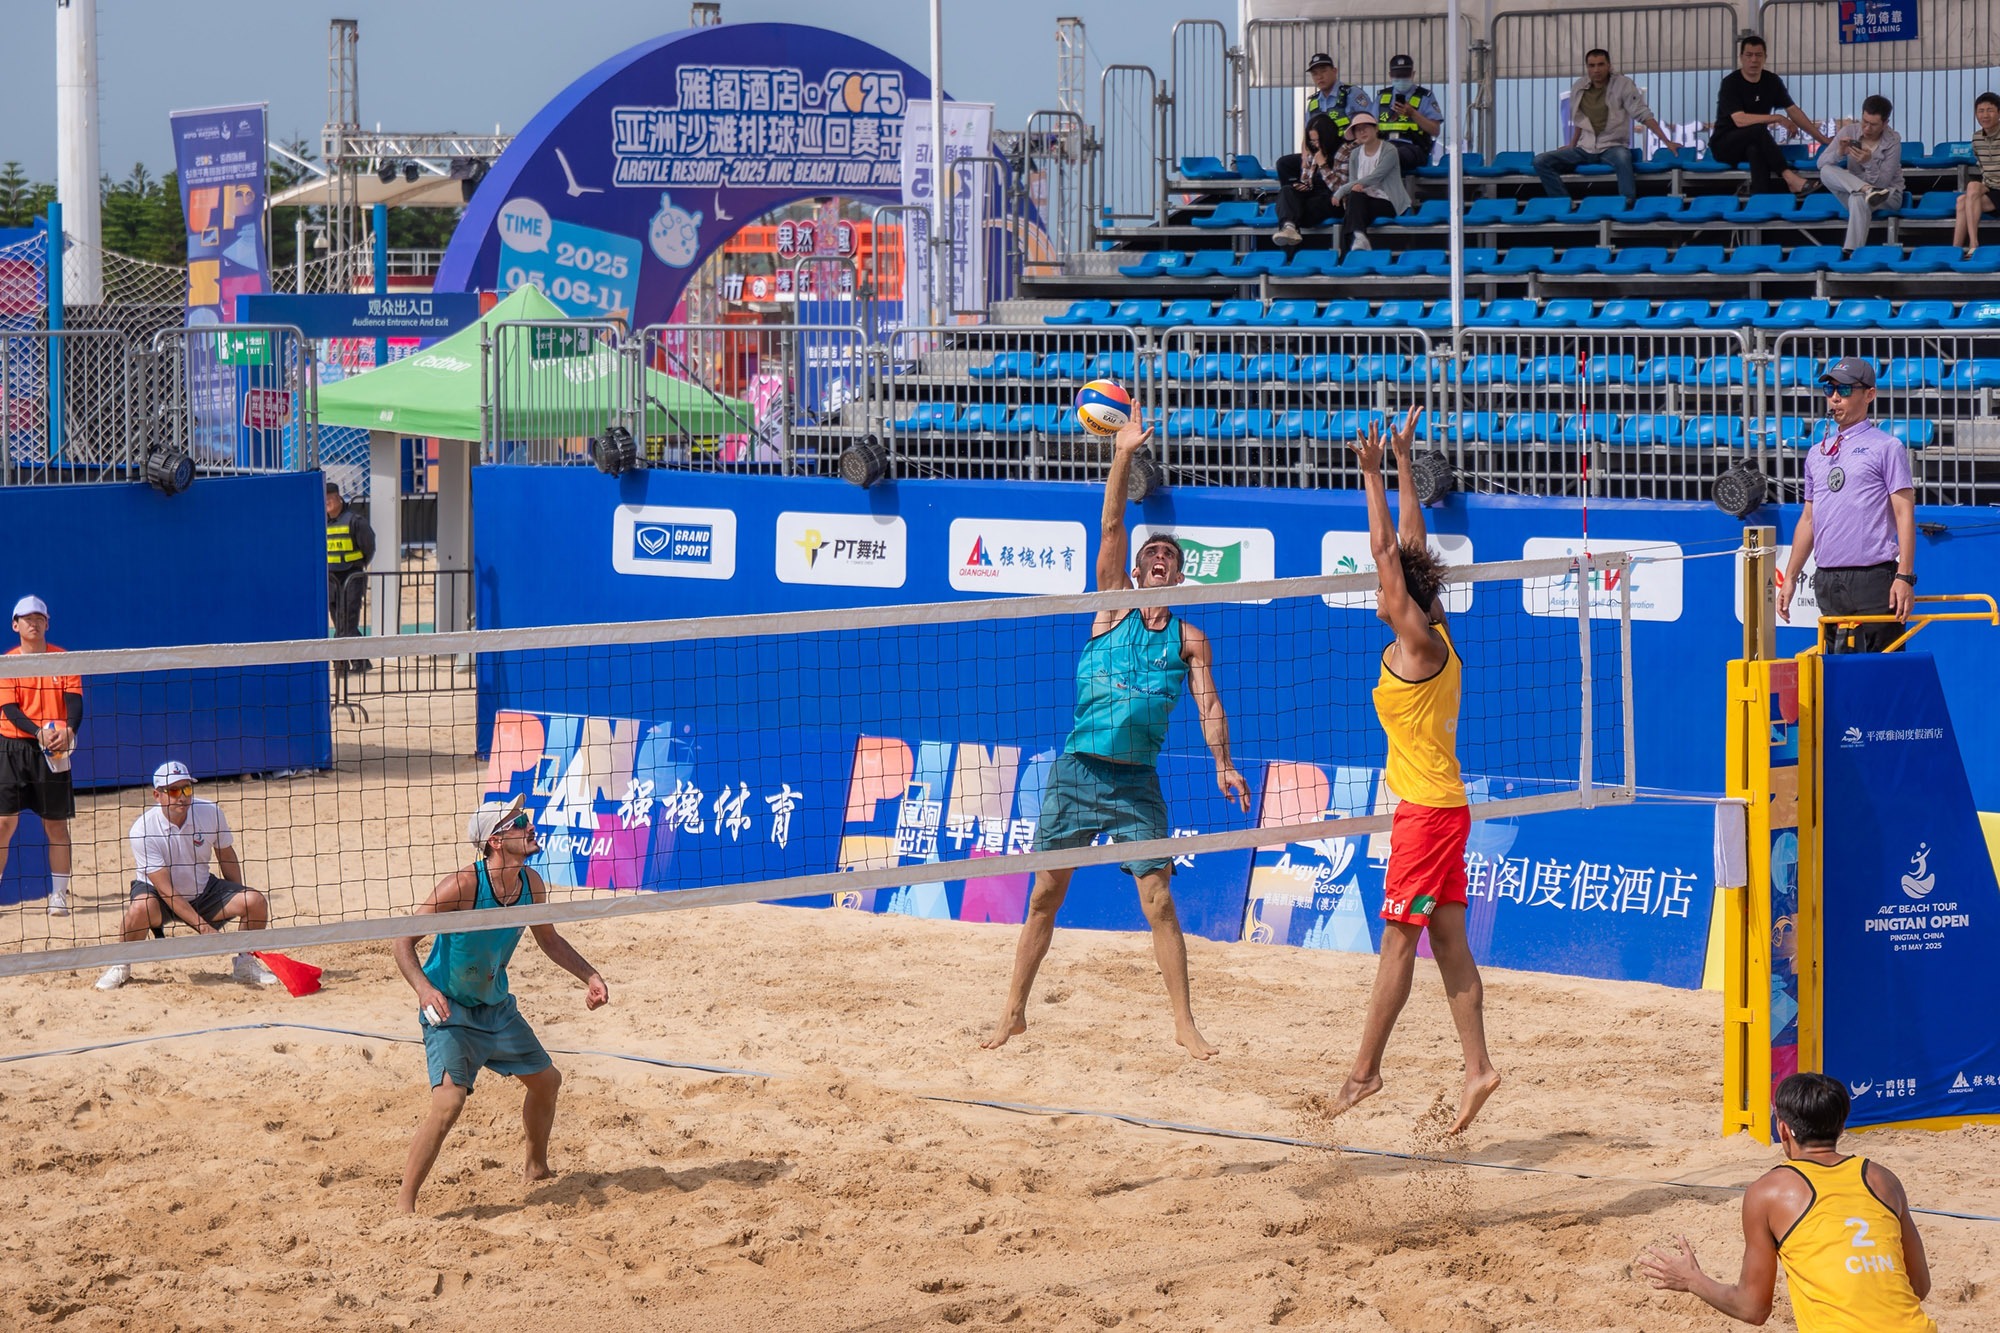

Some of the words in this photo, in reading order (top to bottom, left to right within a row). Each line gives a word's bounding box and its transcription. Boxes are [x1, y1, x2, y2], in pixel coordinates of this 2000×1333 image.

[1854, 10, 1903, 26] 请勿倚靠
[1868, 24, 1901, 34] LEANING
[681, 71, 798, 112] 雅阁酒店
[618, 160, 668, 182] ARGYLE
[671, 160, 721, 182] RESORT
[731, 161, 767, 183] 2025
[767, 162, 794, 183] AVC
[794, 162, 835, 184] BEACH
[836, 163, 870, 184] TOUR
[504, 213, 543, 237] TIME
[555, 242, 629, 280] 2025
[368, 299, 433, 316] 观众出入口
[352, 317, 385, 327] Audience
[386, 317, 418, 327] Entrance
[419, 317, 433, 327] And
[434, 317, 448, 327] Exit
[674, 530, 710, 543] GRAND
[674, 544, 709, 557] SPORT
[833, 539, 887, 561] PT舞社
[999, 545, 1076, 572] 强槐体育
[958, 568, 1000, 578] QIANGHUAI
[617, 777, 803, 850] 强槐体育
[1271, 852, 1331, 882] Argyle
[1309, 881, 1356, 895] Resort
[1898, 904, 1930, 914] BEACH
[1932, 902, 1957, 912] TOUR
[1865, 916, 1927, 932] PINGTAN
[1930, 914, 1969, 928] OPEN
[1890, 933, 1922, 941] PINGTAN,
[1923, 932, 1945, 940] CHINA
[1908, 943, 1923, 951] MAY
[1925, 942, 1943, 950] 2025
[1875, 1088, 1916, 1098] YMCC
[1844, 1216, 1876, 1248] 2
[1844, 1254, 1895, 1274] CHN
